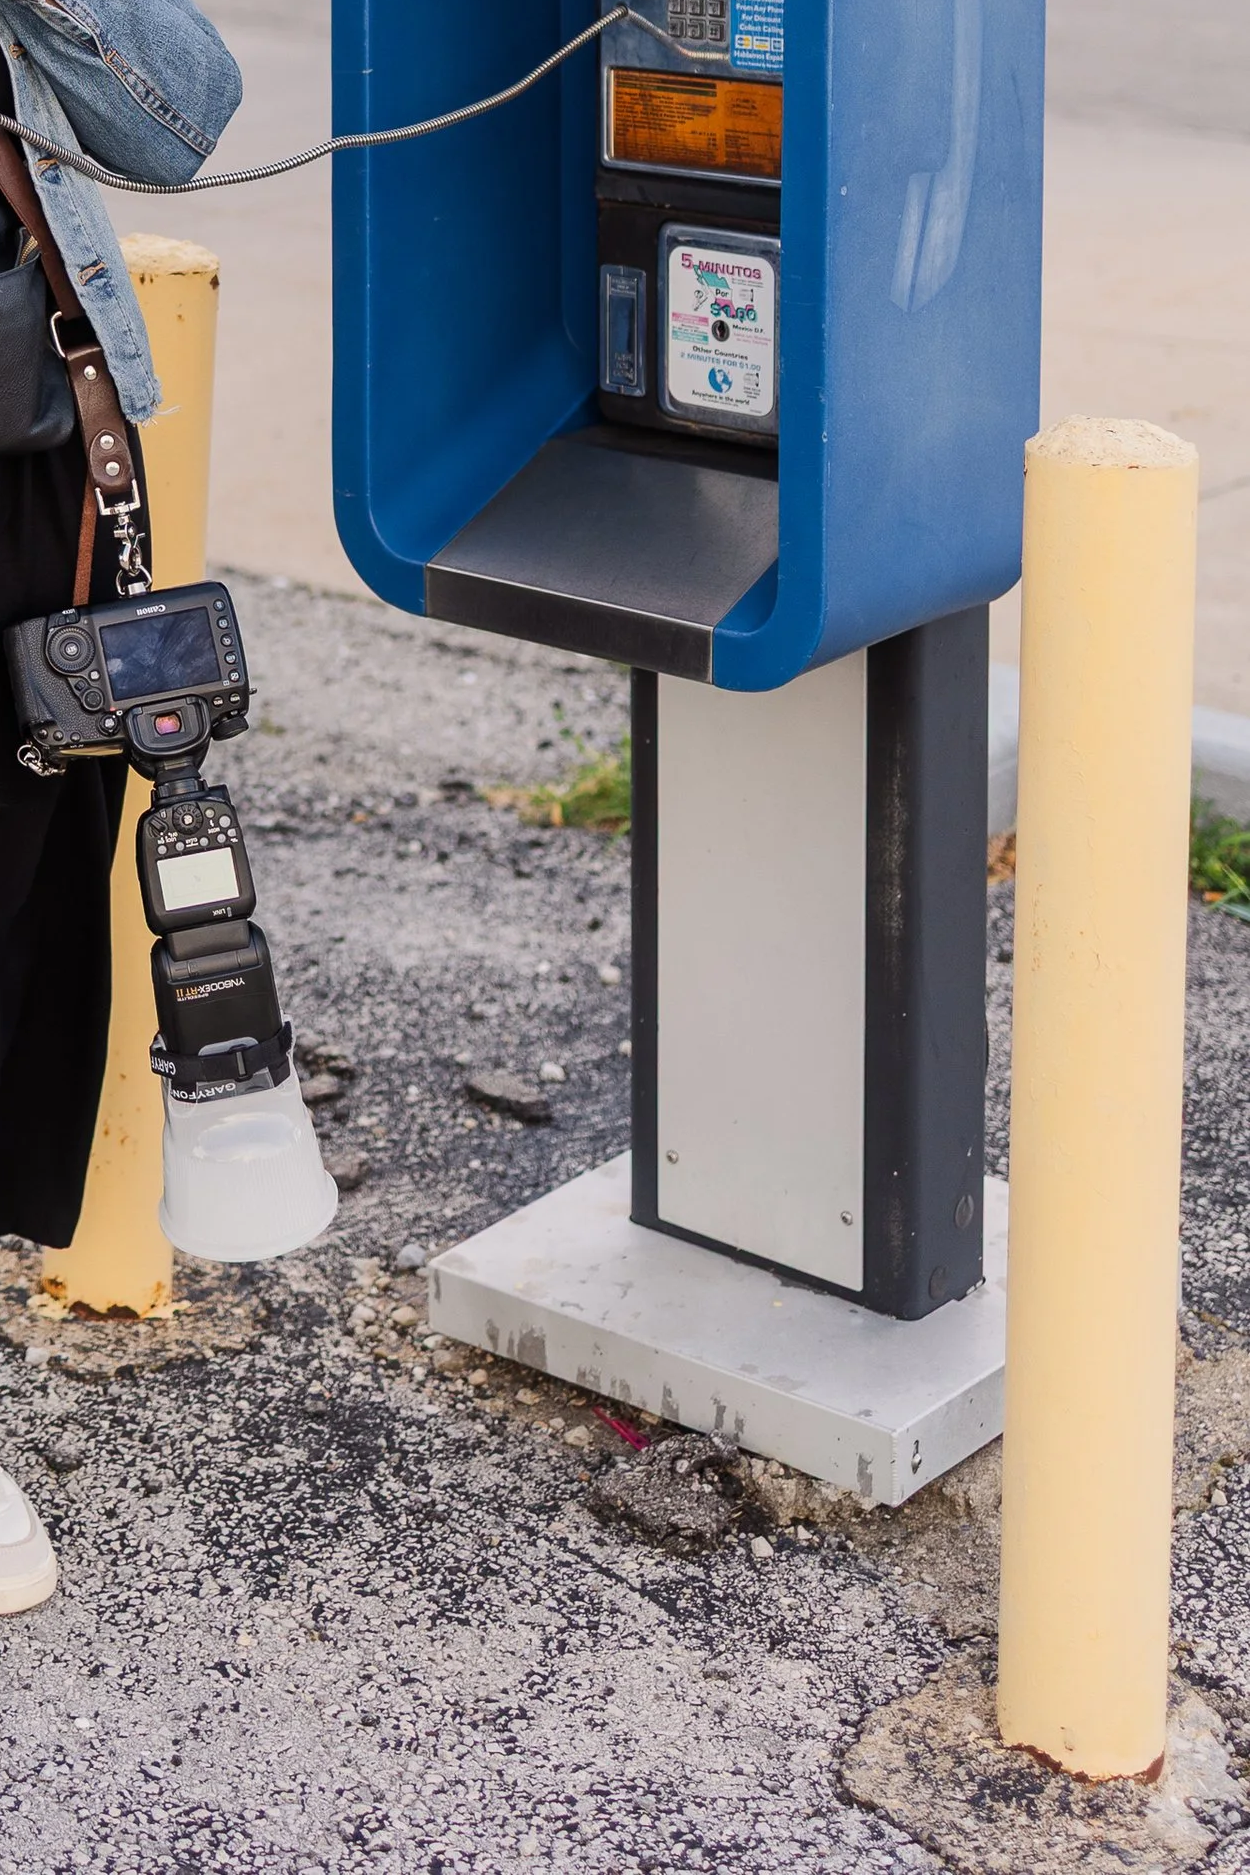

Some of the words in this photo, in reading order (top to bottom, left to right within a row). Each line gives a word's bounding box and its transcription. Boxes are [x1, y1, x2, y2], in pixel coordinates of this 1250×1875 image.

[767, 5, 784, 14] Phon
[681, 253, 694, 271] 5
[698, 260, 763, 280] MINUTOS
[715, 288, 729, 298] Por
[710, 303, 758, 322] $1.00
[692, 345, 712, 354] Other
[714, 347, 748, 360] Countries
[686, 353, 720, 365] MINUTES
[722, 359, 738, 367] FOR
[739, 361, 761, 371] $1.00
[692, 390, 717, 400] Anywhere
[135, 603, 166, 617] Canon
[212, 908, 226, 916] LINK
[185, 977, 245, 996] YN600EX-RT
[170, 1082, 236, 1100] GARYFON
